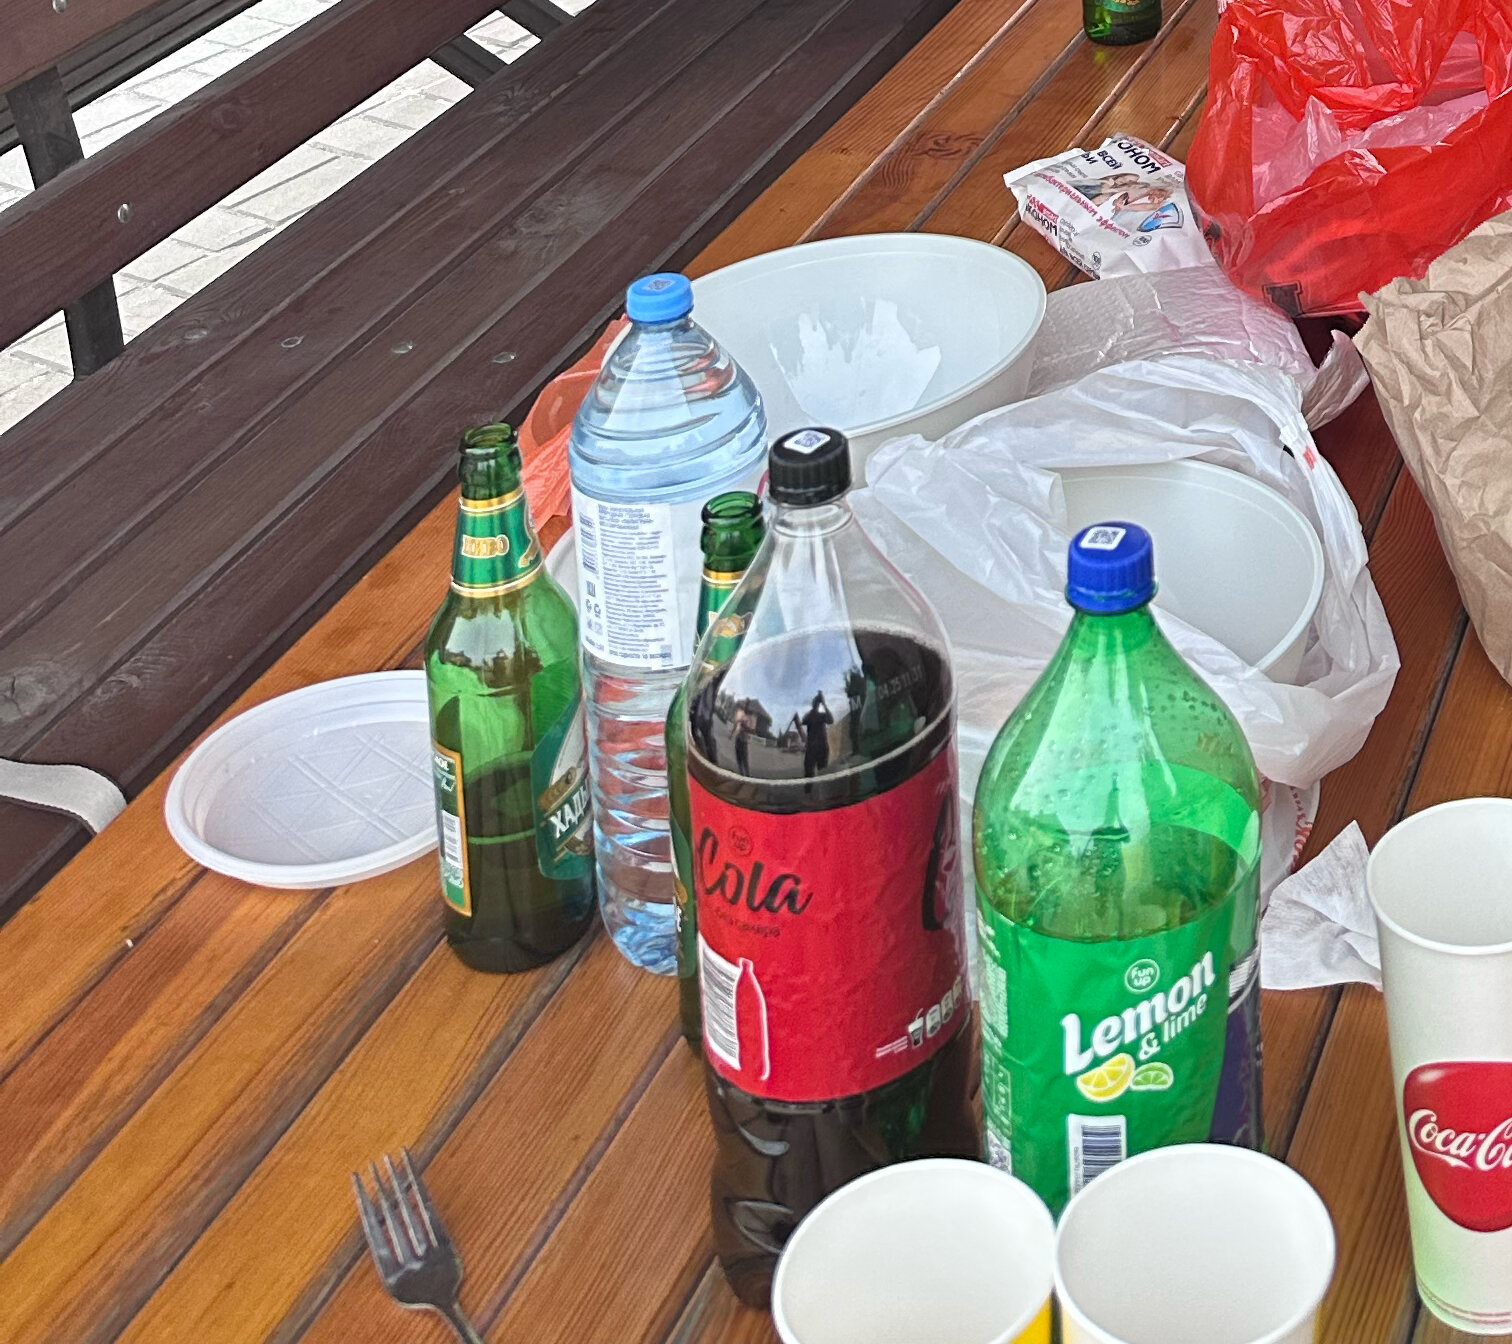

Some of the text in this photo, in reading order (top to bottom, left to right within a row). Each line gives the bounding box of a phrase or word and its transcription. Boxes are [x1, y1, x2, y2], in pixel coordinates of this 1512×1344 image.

[1117, 140, 1162, 174] ОНОМ
[699, 827, 813, 915] Cola
[1060, 951, 1216, 1076] Lemon
[1133, 975, 1151, 987] up
[1138, 993, 1208, 1061] & lime
